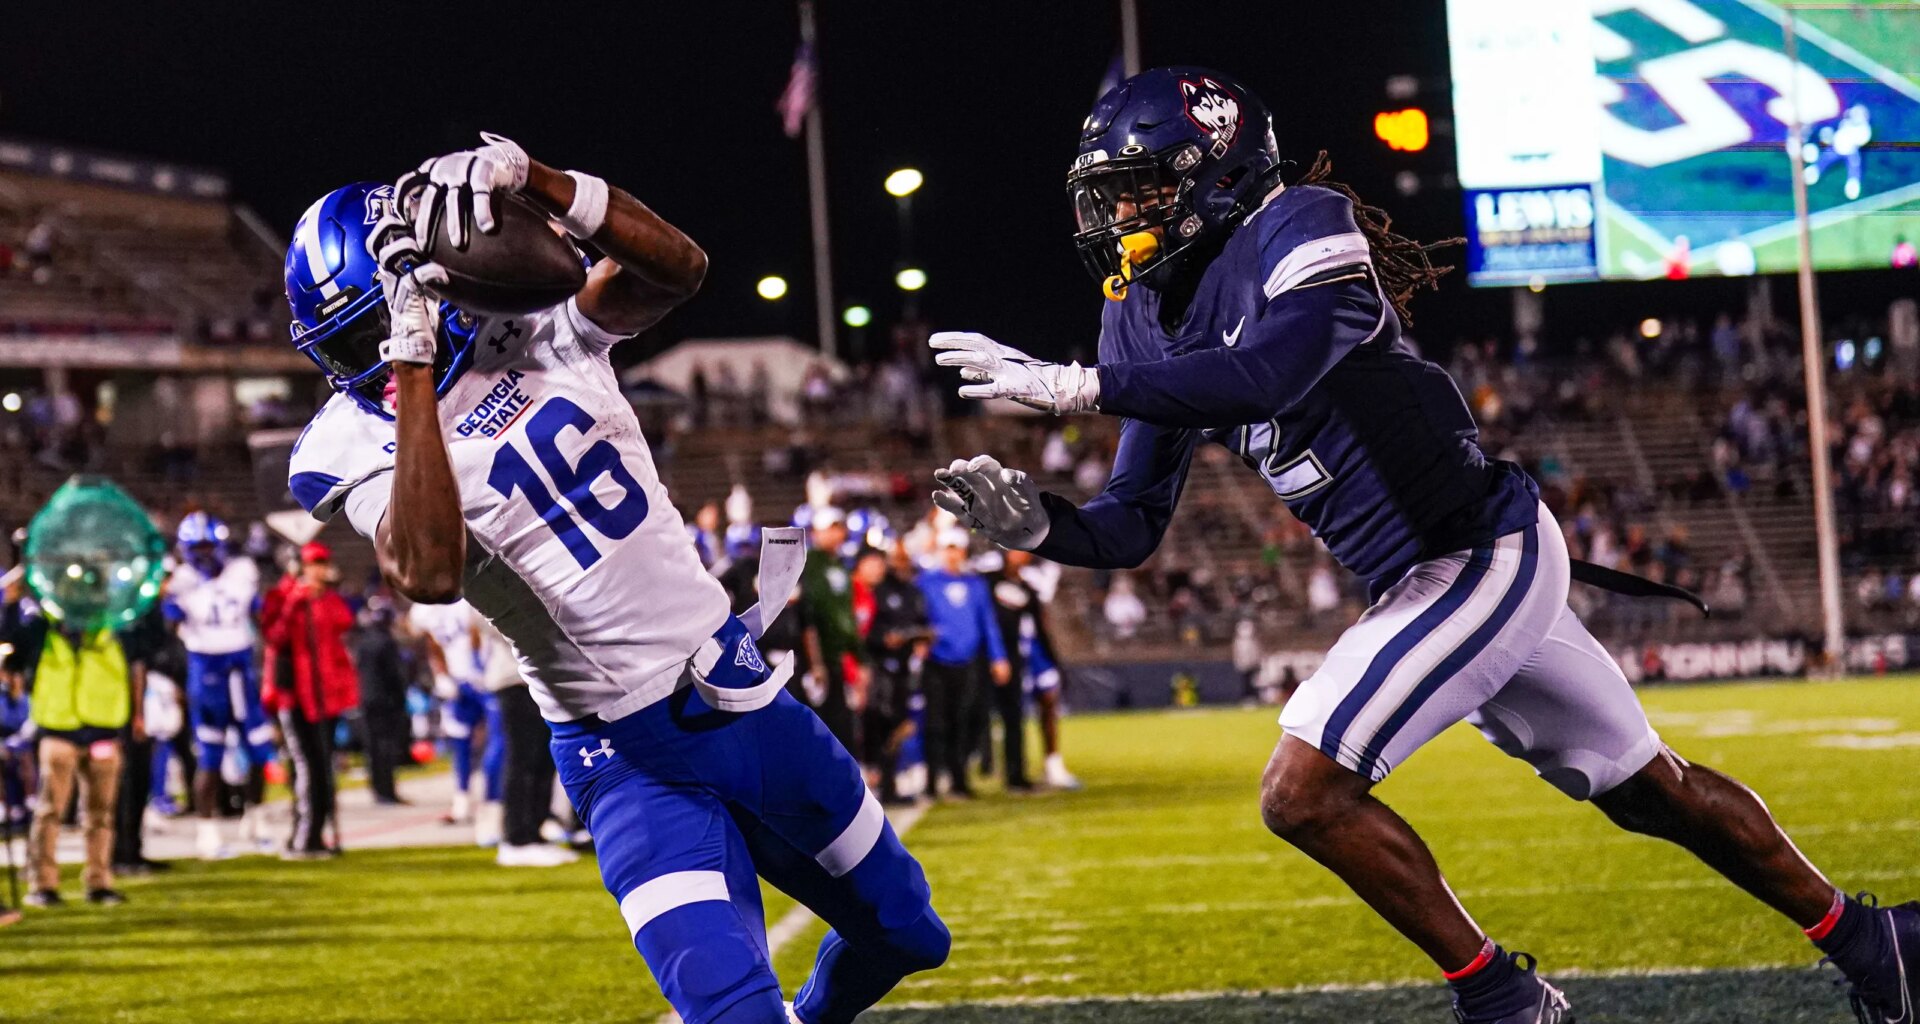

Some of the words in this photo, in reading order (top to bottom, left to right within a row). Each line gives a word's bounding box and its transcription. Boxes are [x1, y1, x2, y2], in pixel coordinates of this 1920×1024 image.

[1475, 187, 1594, 233] LEWIS
[456, 368, 525, 437] GEORGIA
[479, 387, 530, 438] STATE
[487, 396, 649, 571] 16
